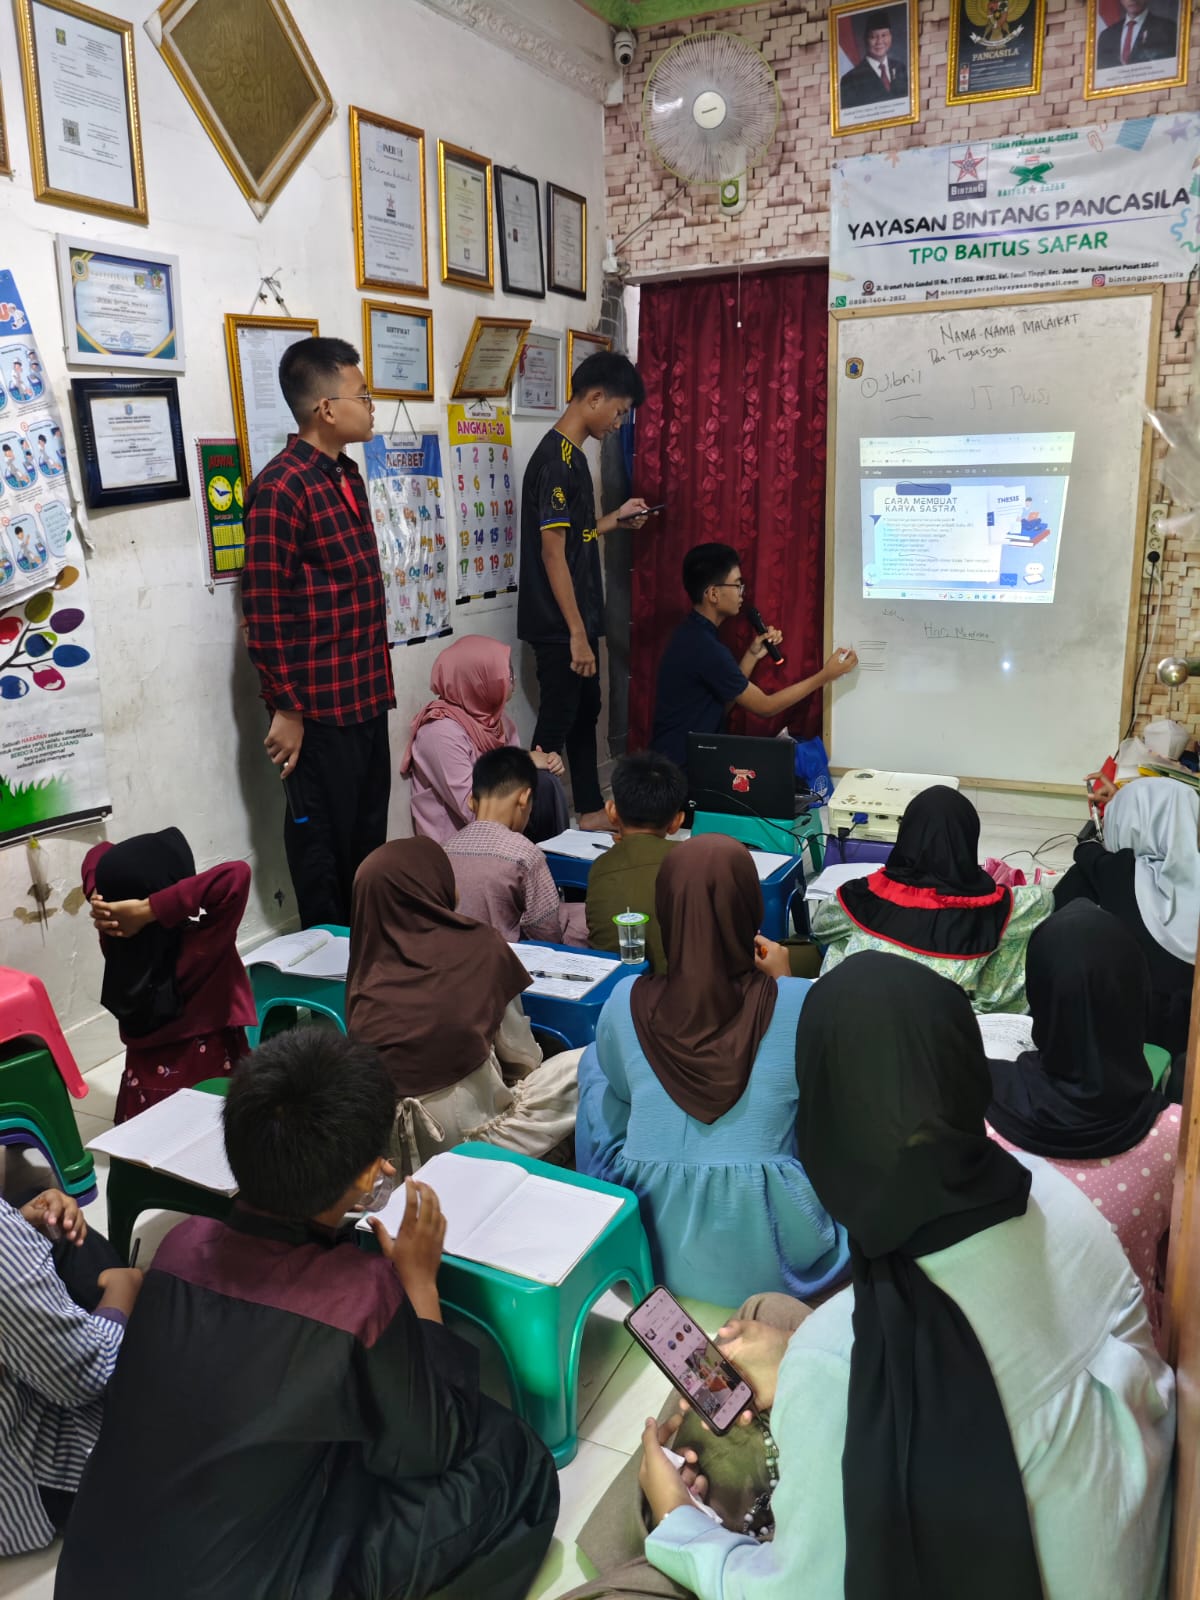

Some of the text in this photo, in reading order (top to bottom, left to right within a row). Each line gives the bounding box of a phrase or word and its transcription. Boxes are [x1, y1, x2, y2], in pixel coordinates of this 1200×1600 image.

[972, 48, 1020, 62] PANCASILA
[951, 183, 985, 196] BINTANG
[848, 187, 1190, 241] YAYASAN BINTANG PANCASILA
[909, 231, 1108, 265] TPQ BAITUS SAFAR
[1022, 313, 1080, 334] MALAIKAT
[457, 421, 505, 436] ANGKA 1-20
[386, 452, 424, 467] ALFABET
[456, 446, 508, 463] 1 2 3 4
[458, 473, 510, 491] 5 6 7 8
[884, 497, 958, 505] CARA MEMBUAT
[919, 504, 957, 512] SASTRA
[997, 495, 1020, 504] THESIS
[461, 499, 513, 518] 9 10 11 12
[459, 526, 513, 546] 13 14 15 16
[459, 552, 514, 575] 17 18 19 20
